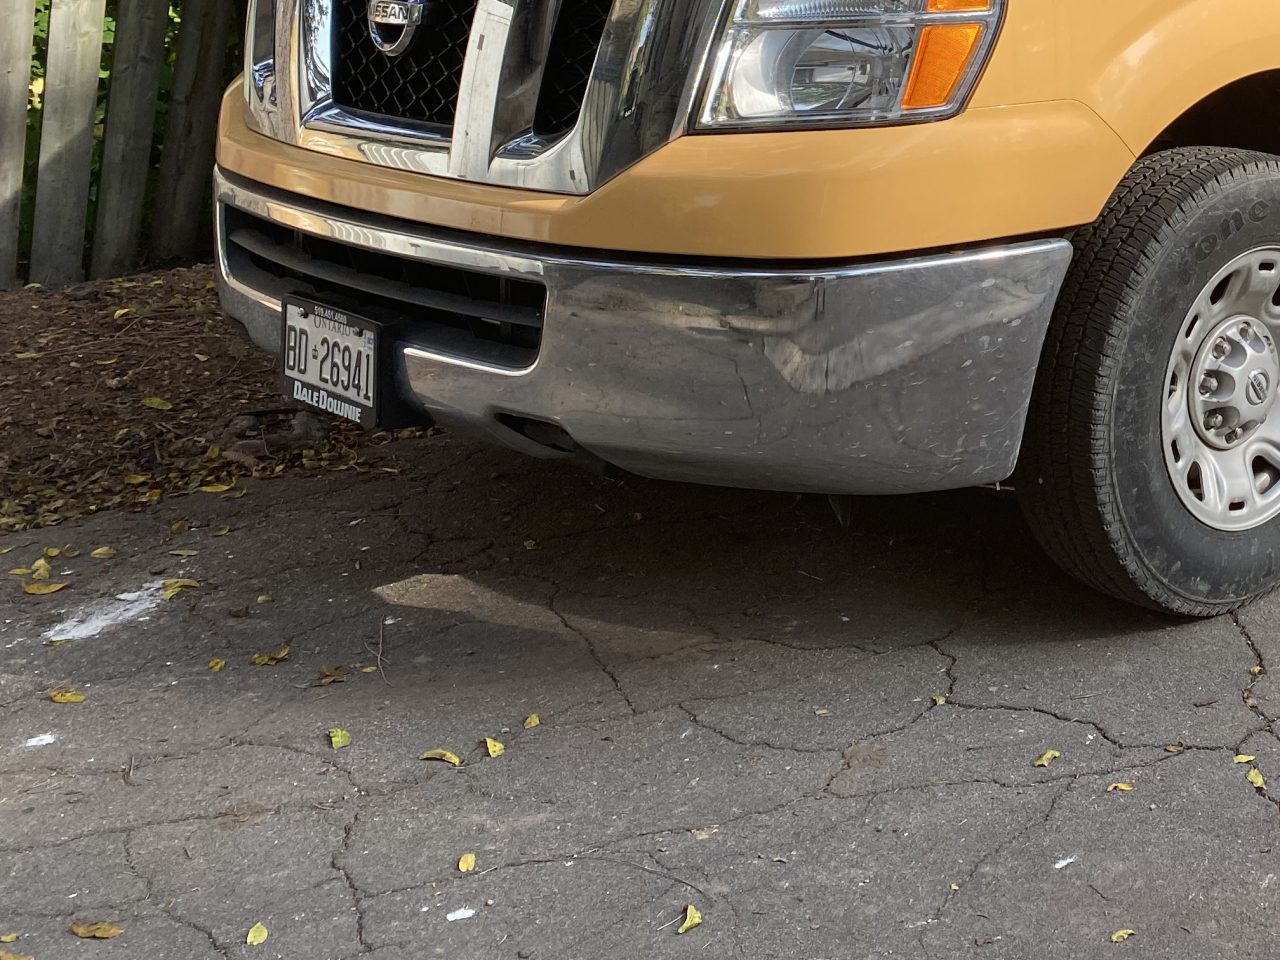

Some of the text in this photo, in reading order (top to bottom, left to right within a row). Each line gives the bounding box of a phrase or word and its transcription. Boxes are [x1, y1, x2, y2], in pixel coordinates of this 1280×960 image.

[313, 316, 351, 337] ONTARIO
[286, 324, 371, 401] BD 26941
